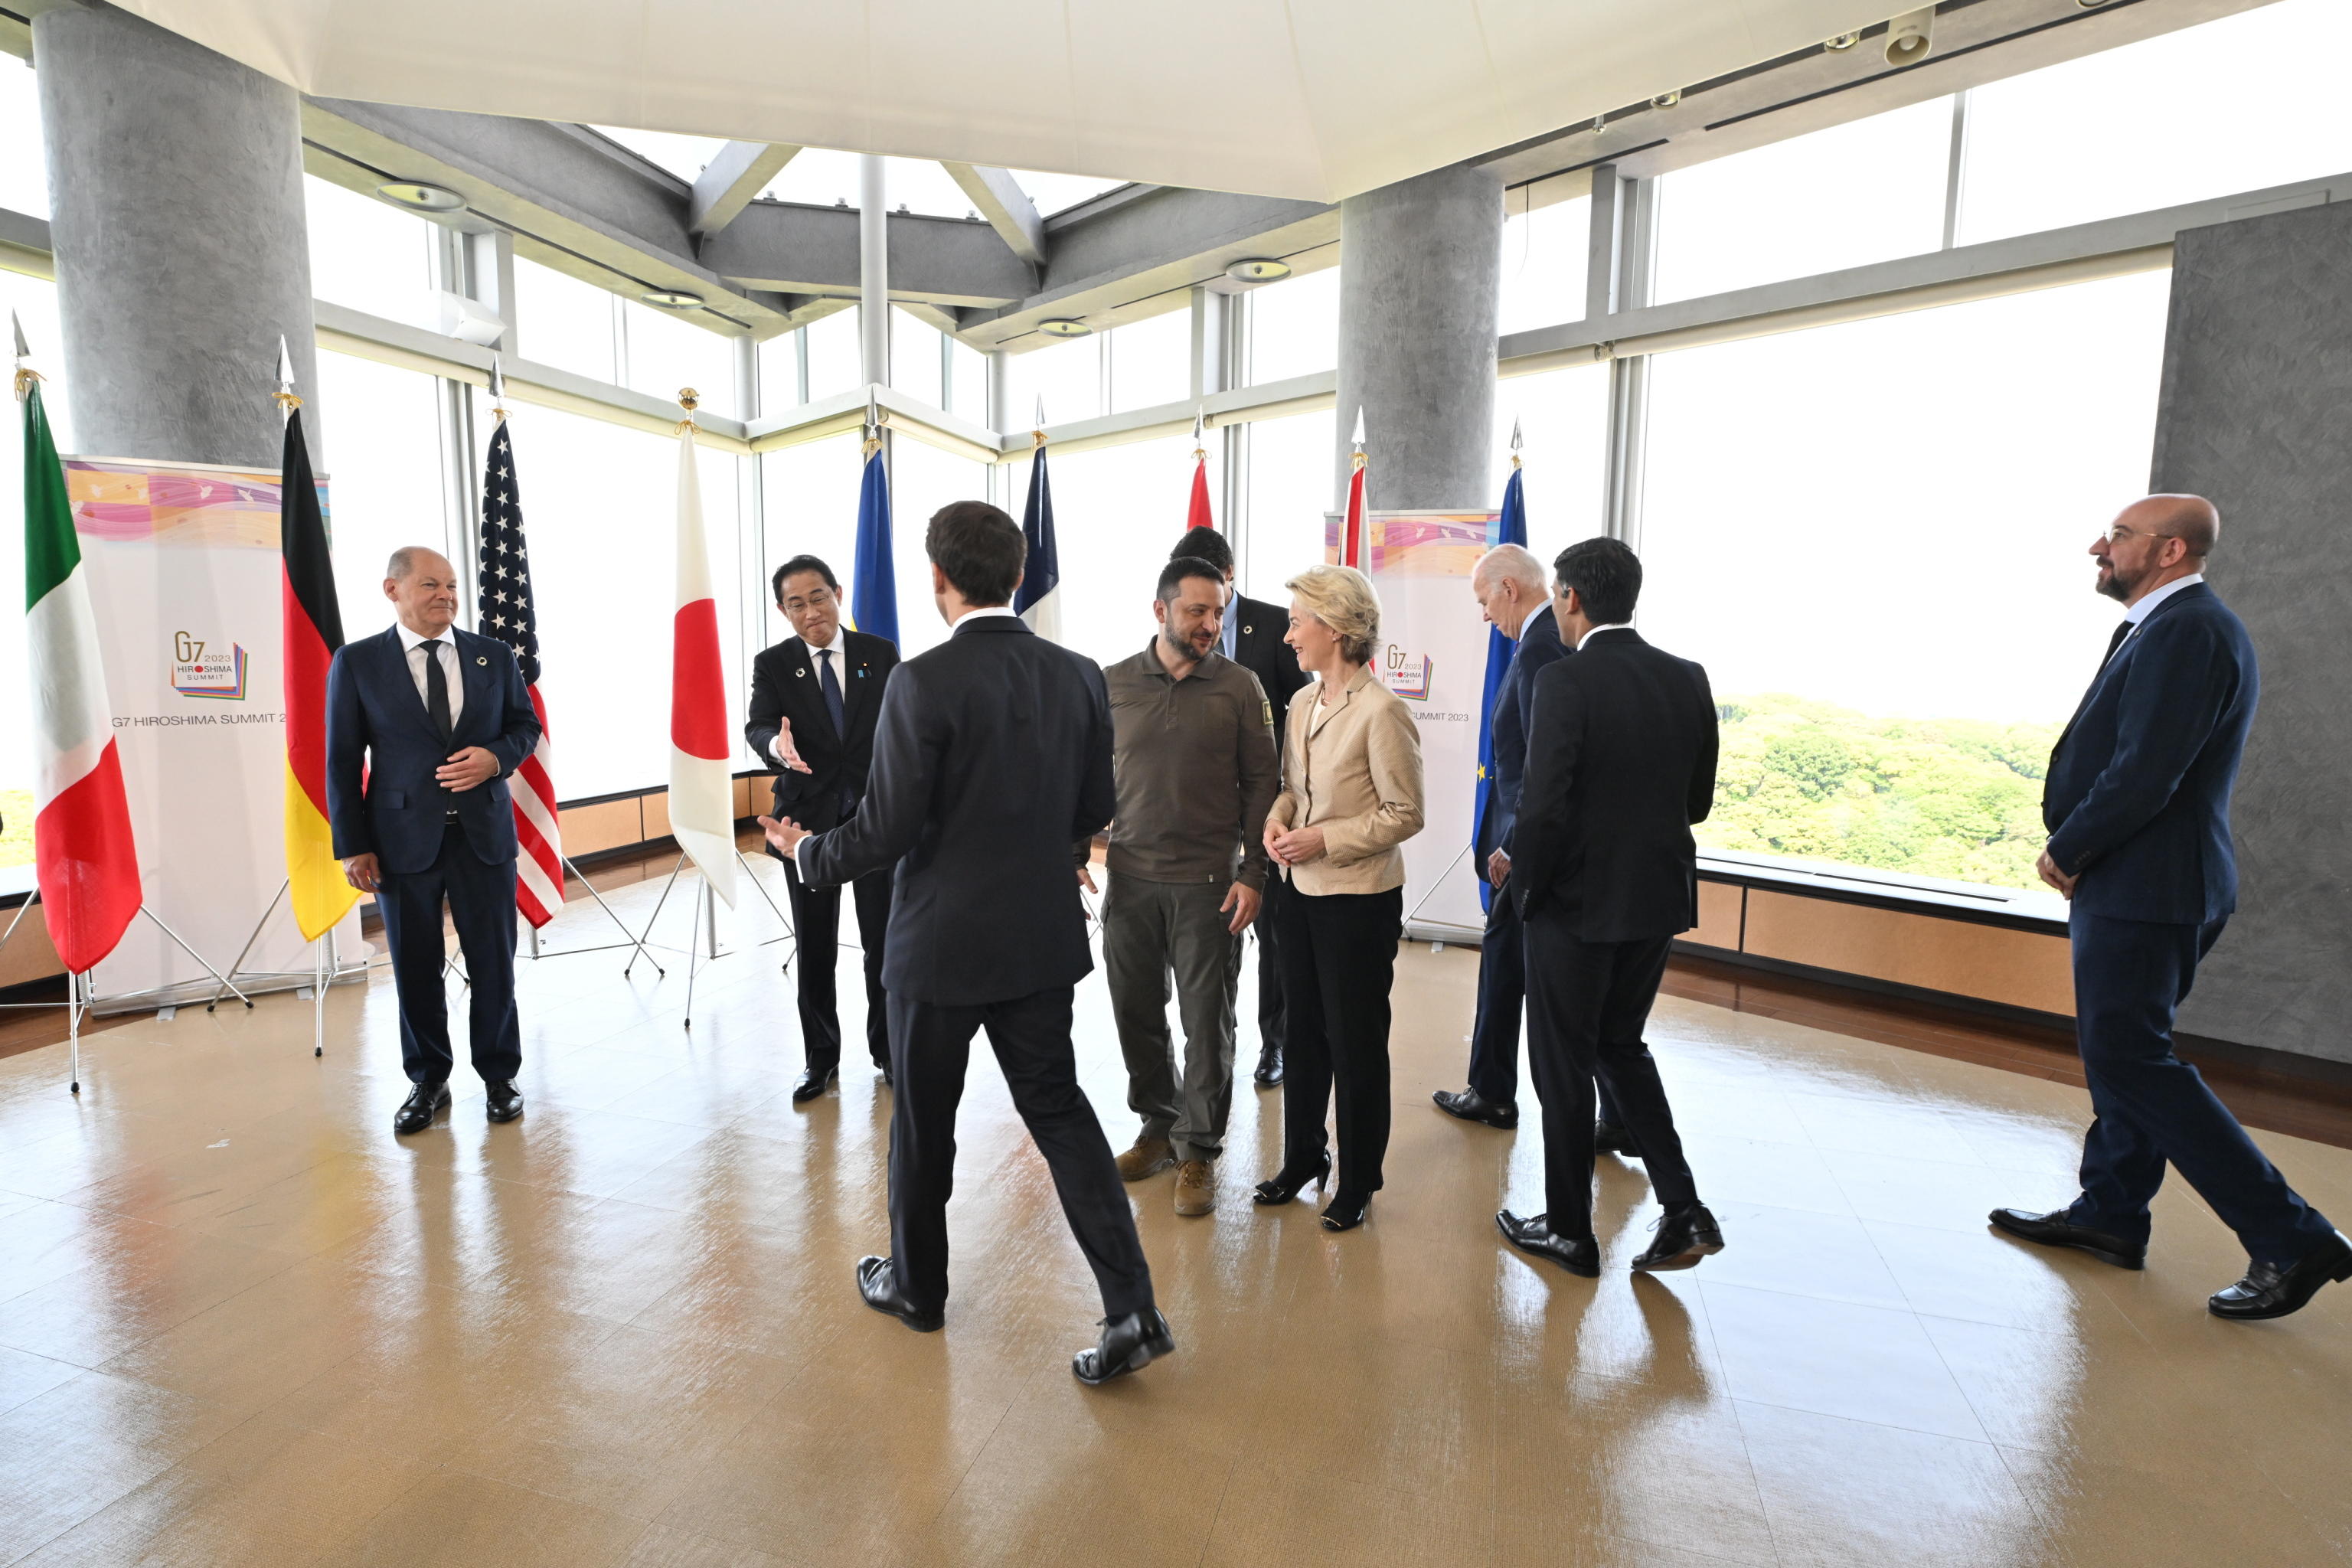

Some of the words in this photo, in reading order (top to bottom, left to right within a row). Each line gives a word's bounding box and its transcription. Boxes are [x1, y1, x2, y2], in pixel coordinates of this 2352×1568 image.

[175, 631, 204, 663] G7
[1387, 645, 1406, 669] G7
[112, 717, 130, 727] G7
[134, 715, 217, 727] HIROSHIMA
[220, 714, 276, 724] SUMMIT
